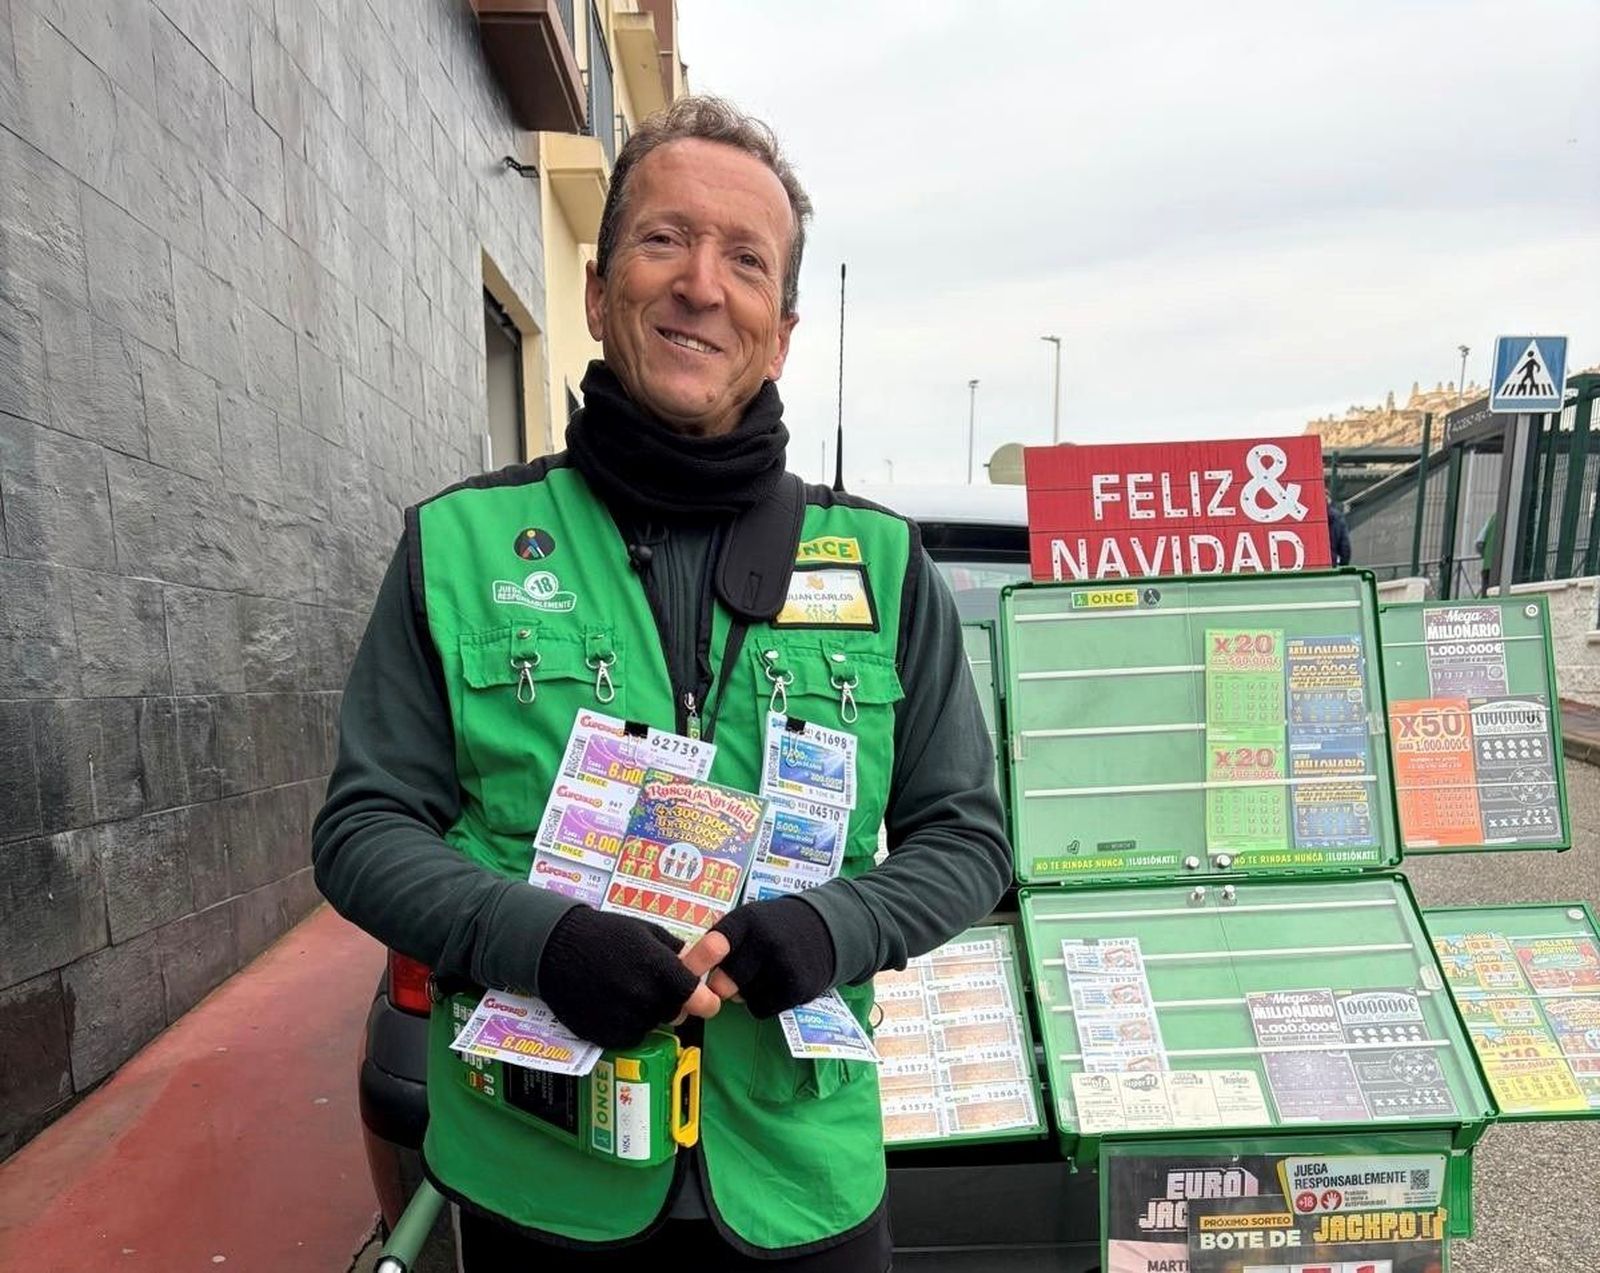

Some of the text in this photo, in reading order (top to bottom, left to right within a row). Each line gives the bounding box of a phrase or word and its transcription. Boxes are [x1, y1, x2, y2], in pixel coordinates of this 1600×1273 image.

[1091, 443, 1309, 523] FELIZ &
[802, 540, 854, 558] NCE
[1050, 530, 1306, 582] NAVIDAD
[814, 592, 854, 602] CARLOS
[1091, 591, 1135, 605] ONCE
[1444, 609, 1483, 624] Mega
[1427, 622, 1501, 640] MILLONARIO
[651, 735, 699, 758] 62739
[814, 730, 847, 749] 41698
[1415, 738, 1468, 752] 1.000.000€
[585, 775, 608, 787] ONCE
[650, 783, 692, 800] Rasca
[702, 790, 757, 826] Navidad
[809, 804, 840, 822] 04510
[562, 844, 584, 857] ONCE
[1232, 855, 1246, 865] NO
[1248, 855, 1258, 865] TE
[1260, 853, 1293, 865] RINDAS
[1295, 852, 1324, 863] NUNCA
[1036, 861, 1049, 871] NO
[1050, 860, 1061, 870] TE
[1062, 859, 1094, 870] RINDAS
[1095, 858, 1124, 869] NUNCA
[794, 878, 819, 889] 045
[1272, 993, 1310, 1006] Mega
[1339, 998, 1419, 1016] 1000000€
[1253, 1004, 1334, 1019] MILLONARIO
[595, 1068, 609, 1125] ONCE
[1293, 1163, 1328, 1177] JUEGA
[1166, 1170, 1242, 1200] EURO
[1294, 1170, 1407, 1190] RESPONSABLEMENTE
[1204, 1215, 1291, 1228] PRÓXIMO SORTEO
[1312, 1210, 1437, 1243] JACKPOT
[1200, 1229, 1301, 1250] BOTE DE
